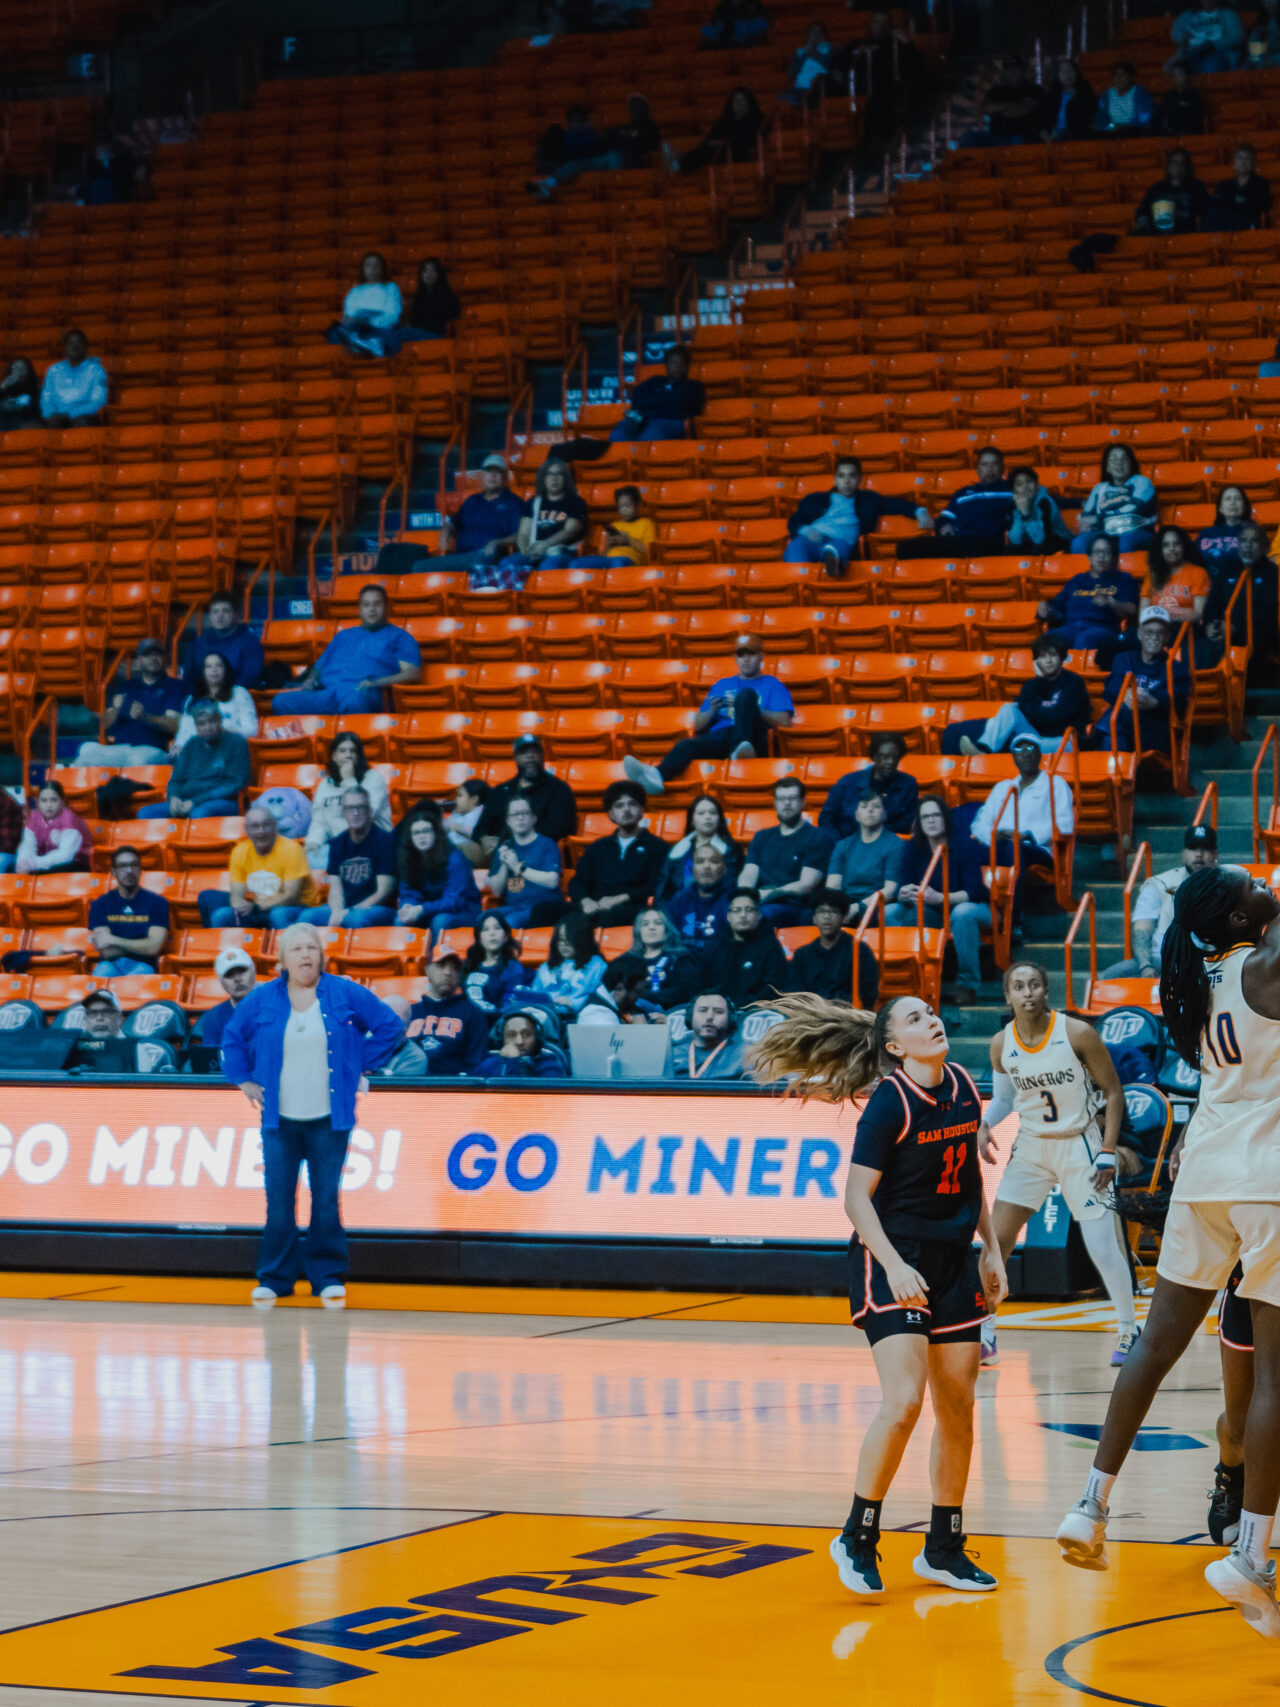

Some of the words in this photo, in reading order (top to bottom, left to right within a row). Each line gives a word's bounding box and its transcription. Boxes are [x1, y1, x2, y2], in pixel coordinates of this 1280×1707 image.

[281, 36, 297, 62] F
[406, 1015, 463, 1038] UTEP
[1204, 1011, 1243, 1068] 10
[1013, 1068, 1075, 1091] MINEROS
[1040, 1090, 1059, 1123] 3
[917, 1129, 942, 1145] SAM
[943, 1120, 979, 1140] HOUSTON
[88, 1125, 402, 1192] MINES!
[447, 1132, 559, 1192] GO
[587, 1135, 842, 1199] MINER
[936, 1142, 967, 1195] 11
